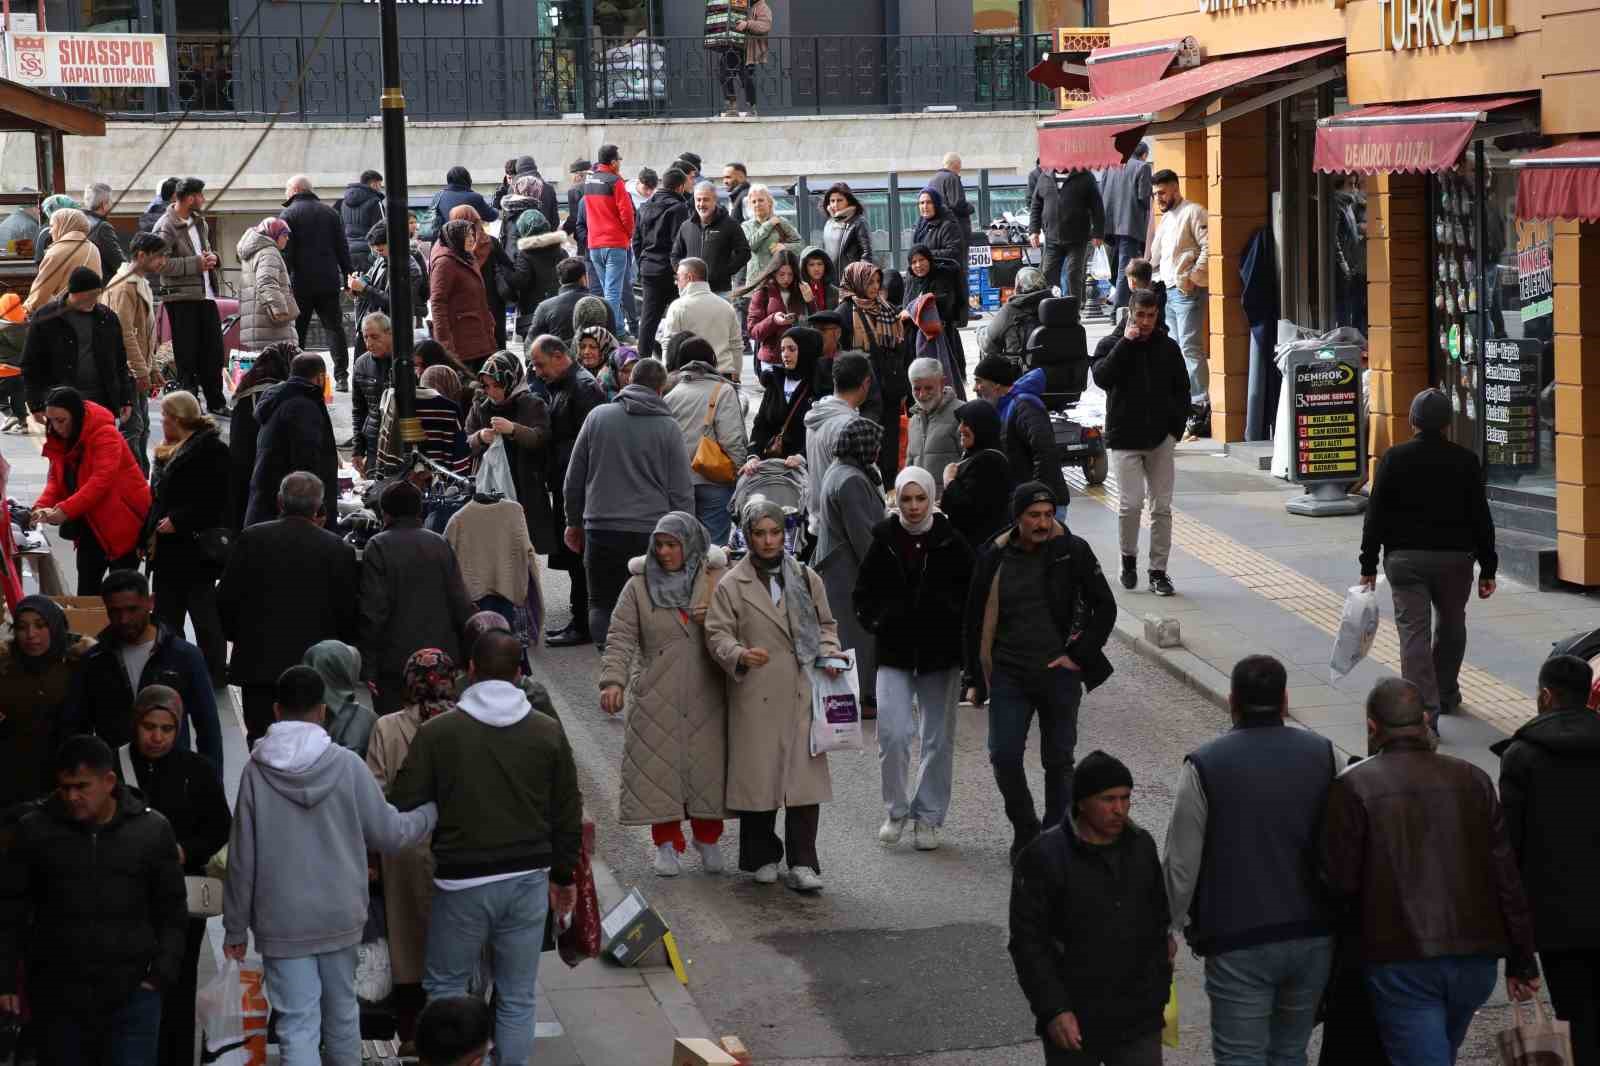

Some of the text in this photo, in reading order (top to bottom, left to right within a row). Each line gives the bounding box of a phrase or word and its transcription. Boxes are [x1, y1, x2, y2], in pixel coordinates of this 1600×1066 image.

[58, 37, 154, 66] SİVASSPOR
[61, 66, 99, 83] KAPALI
[1519, 268, 1553, 301] TELEFON
